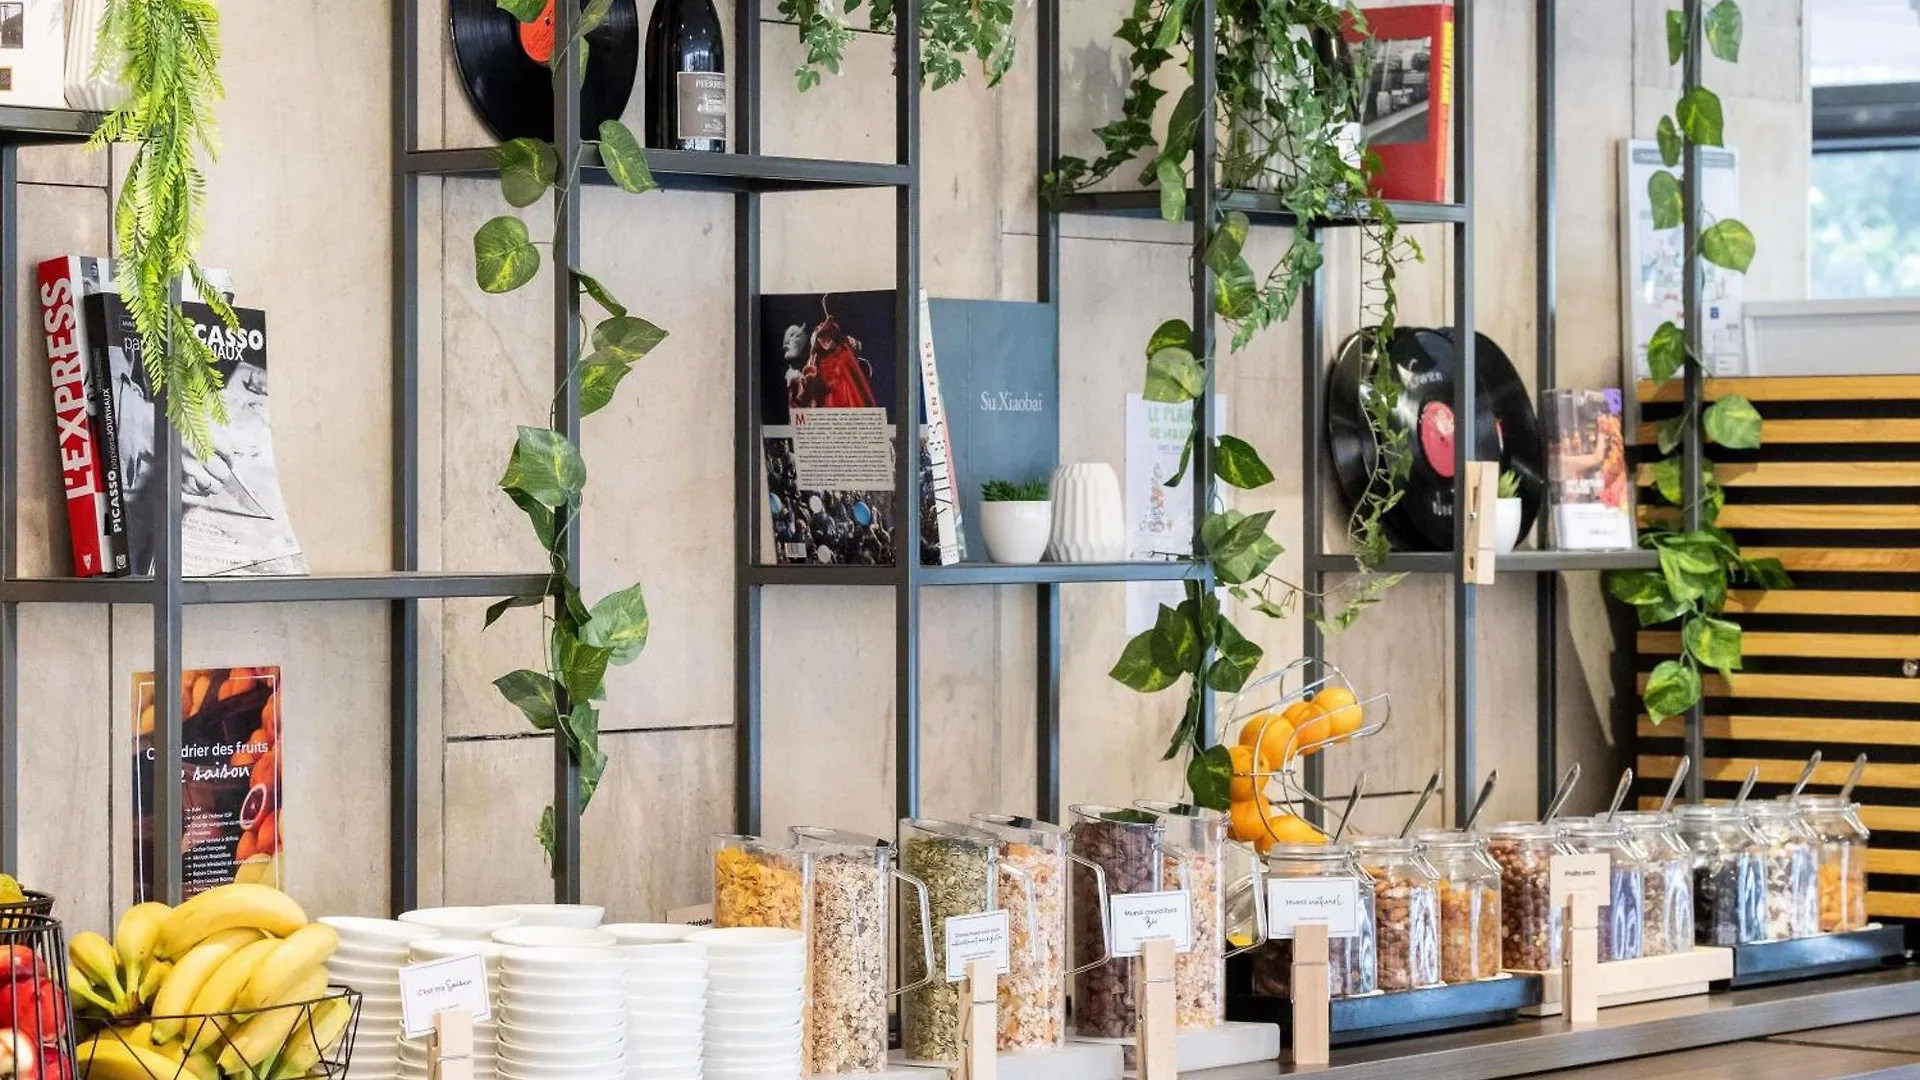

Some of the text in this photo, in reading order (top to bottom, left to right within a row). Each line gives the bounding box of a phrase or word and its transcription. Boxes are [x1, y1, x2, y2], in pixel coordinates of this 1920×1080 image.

[194, 323, 264, 350] CASSO
[41, 278, 95, 499] L'EXPRESS
[981, 391, 1043, 412] Su Xiaobai
[108, 470, 122, 533] PICASSO
[146, 741, 268, 760] Cdrier des fruits
[193, 762, 250, 781] saison
